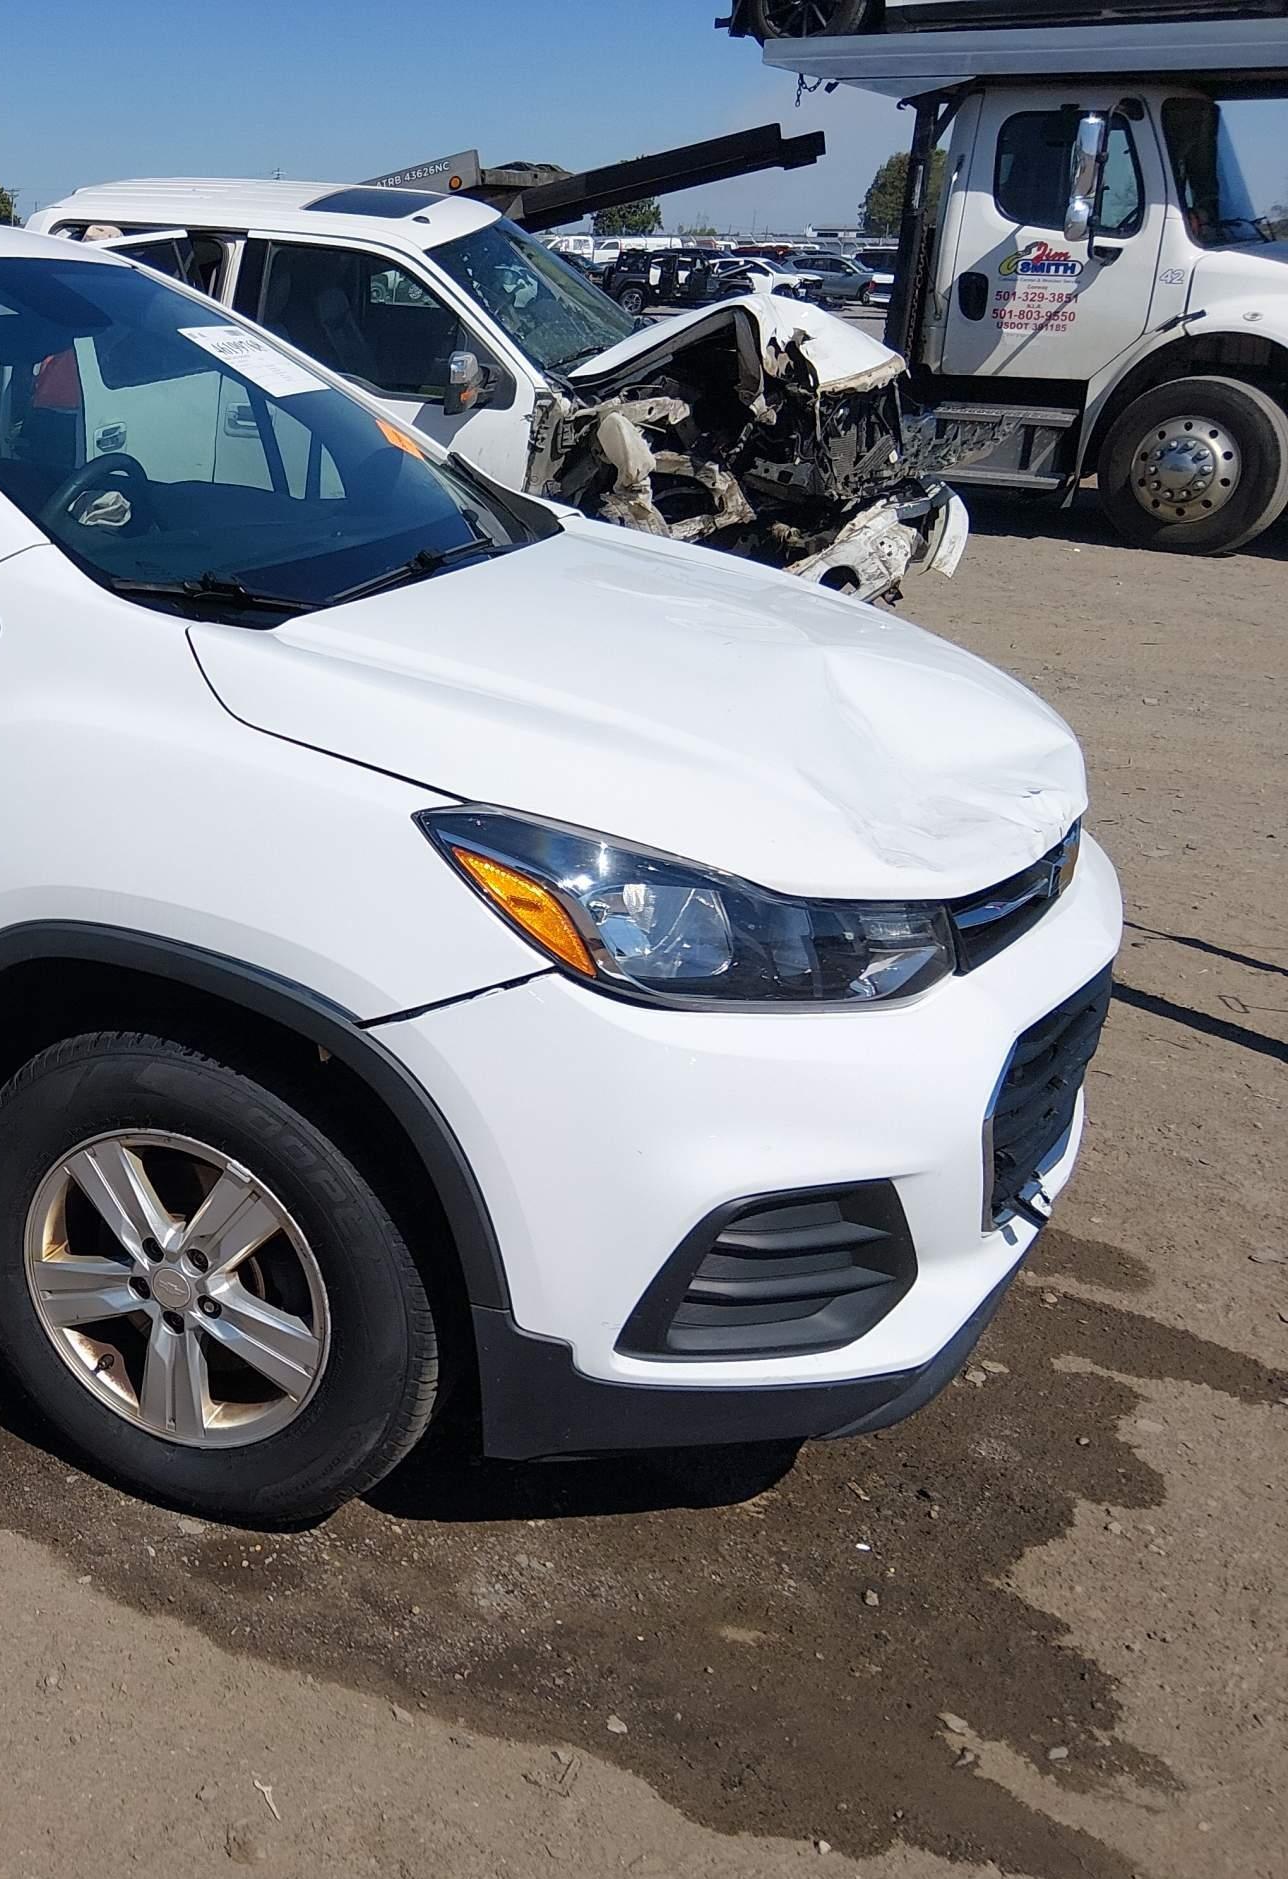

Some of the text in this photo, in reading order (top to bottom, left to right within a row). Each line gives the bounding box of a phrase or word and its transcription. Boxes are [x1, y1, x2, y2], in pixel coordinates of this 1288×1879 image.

[404, 161, 451, 182] 43626NC
[1031, 241, 1071, 264] Jim
[1019, 261, 1077, 275] SMITH
[1159, 268, 1185, 285] 42
[995, 291, 1079, 303] 501-329-3851
[992, 308, 1076, 322] 501-803-9550
[996, 321, 1029, 330] USDOT
